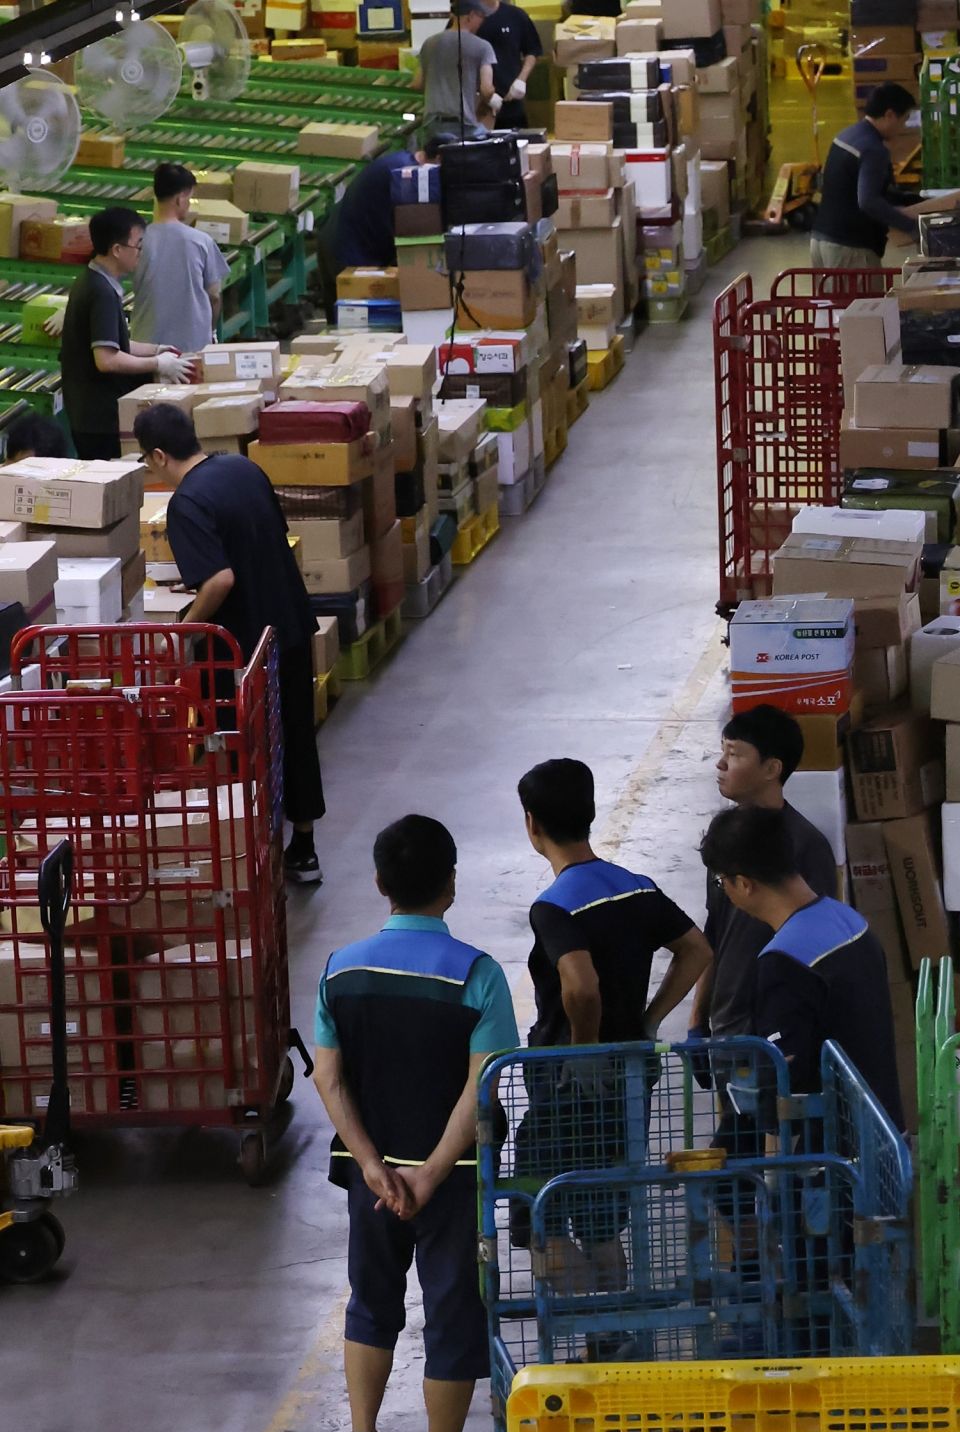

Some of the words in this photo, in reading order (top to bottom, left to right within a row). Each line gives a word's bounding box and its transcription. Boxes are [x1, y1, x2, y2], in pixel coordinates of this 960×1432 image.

[774, 653, 800, 661] KOREA
[801, 653, 820, 661] POST
[902, 856, 927, 930] WORKSOUT
